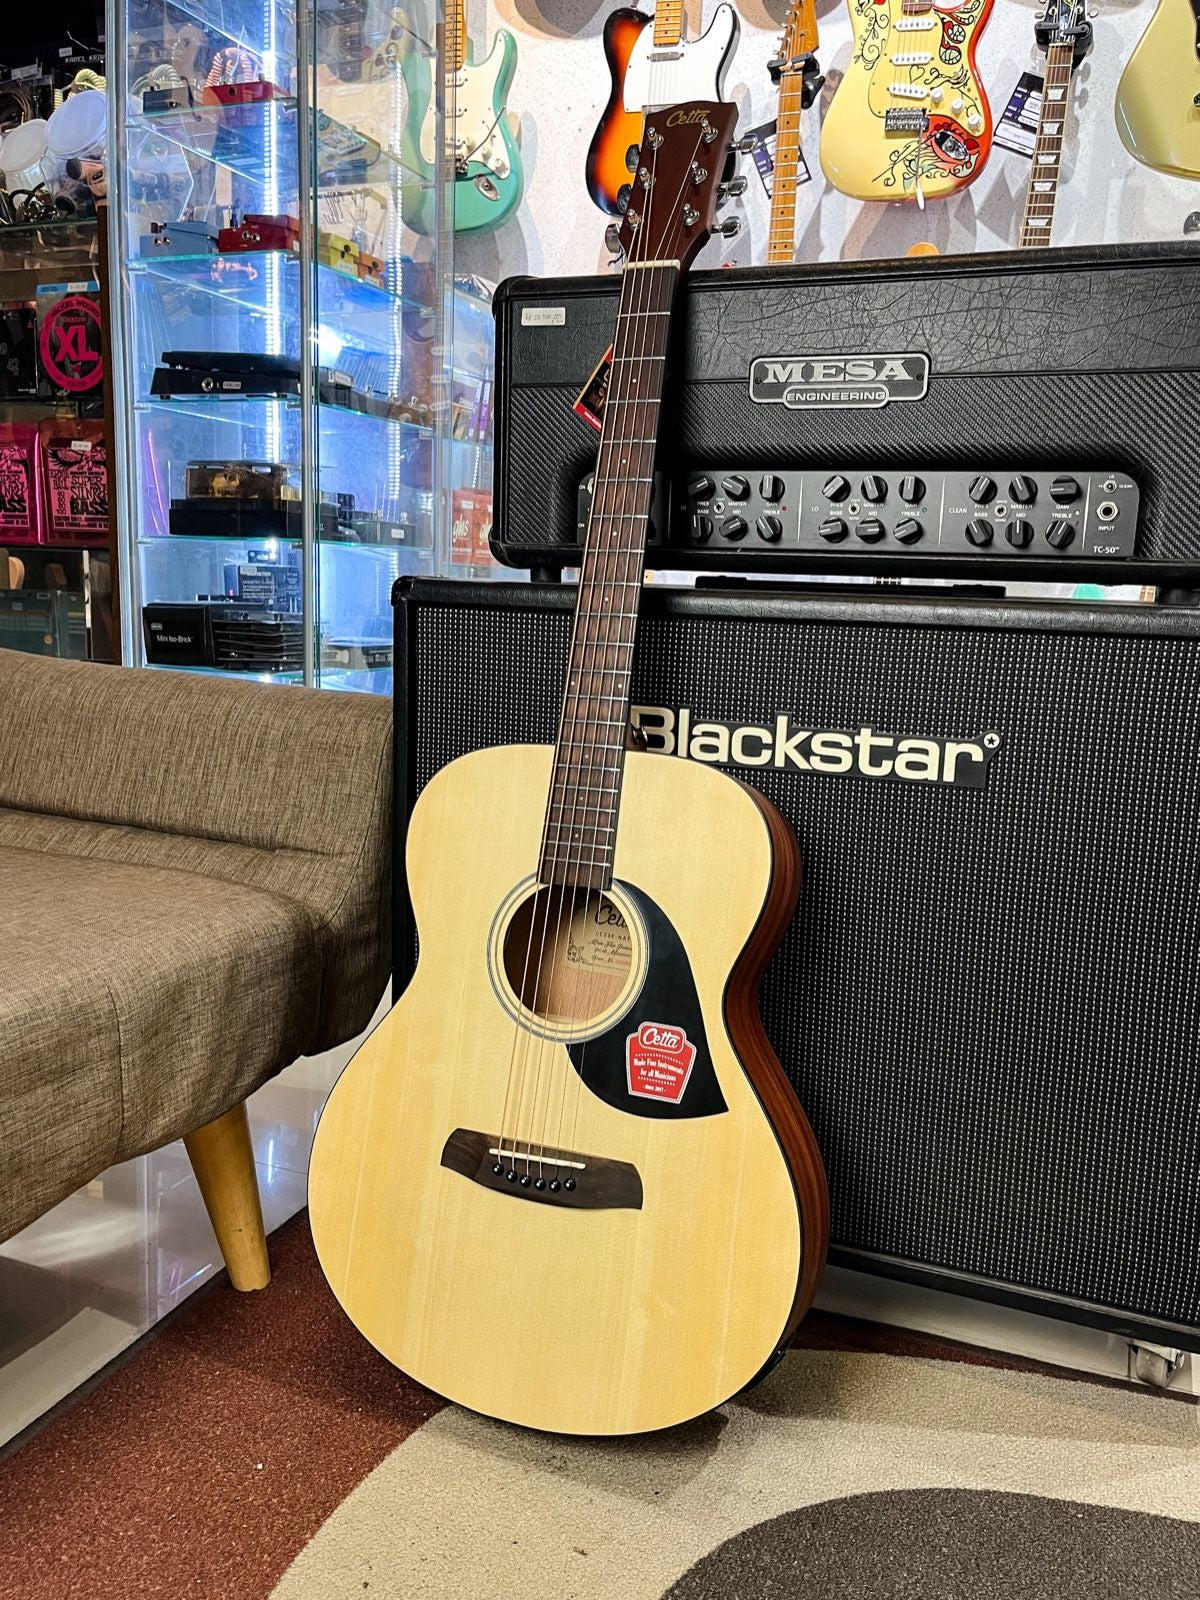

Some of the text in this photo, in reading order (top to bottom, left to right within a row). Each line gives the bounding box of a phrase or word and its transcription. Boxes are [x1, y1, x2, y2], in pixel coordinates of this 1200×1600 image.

[666, 110, 711, 127] Cetta
[55, 325, 98, 362] XL
[763, 359, 914, 384] MESA
[786, 391, 887, 401] ENGINEERING
[0, 475, 22, 485] UPER
[71, 475, 104, 485] SUPER
[0, 499, 26, 513] ASS
[70, 499, 108, 515] BASS
[157, 634, 192, 643] Mini Iso-Brick
[631, 704, 985, 783] Blackstar
[643, 1028, 680, 1048] Cetta
[633, 1058, 684, 1075] Made Fine Instruments
